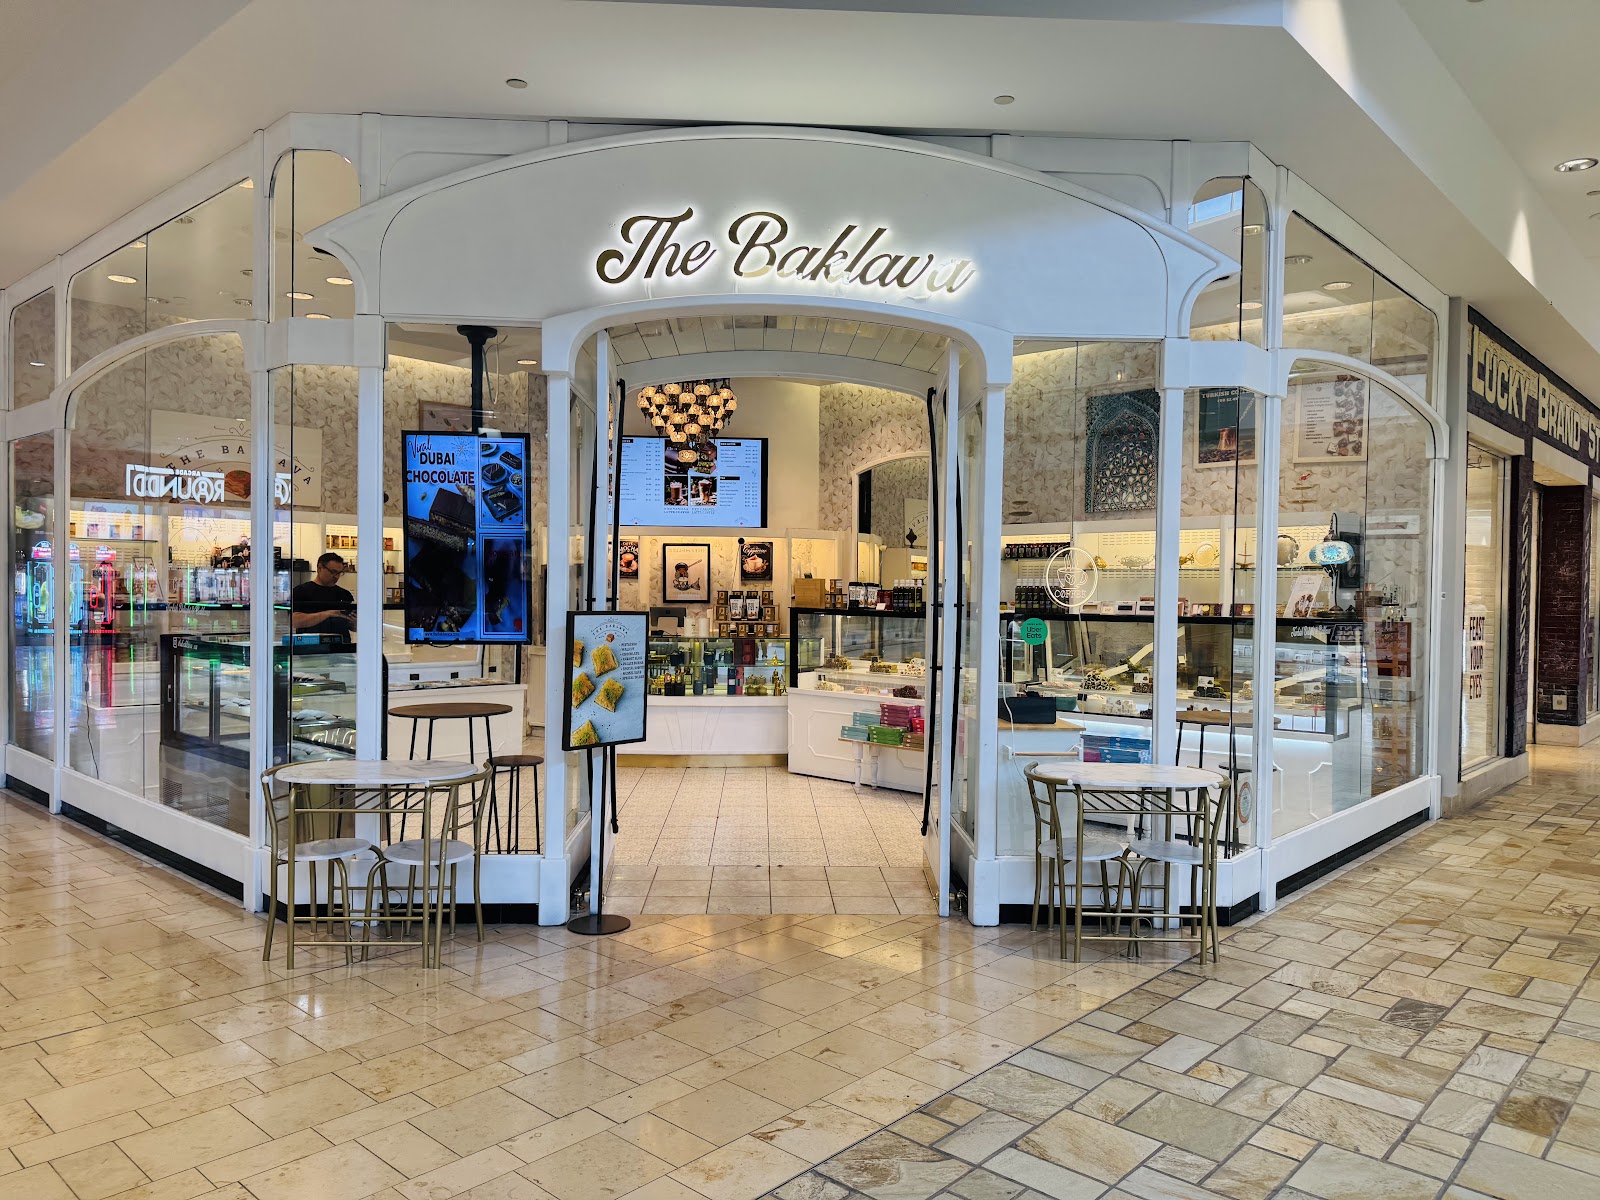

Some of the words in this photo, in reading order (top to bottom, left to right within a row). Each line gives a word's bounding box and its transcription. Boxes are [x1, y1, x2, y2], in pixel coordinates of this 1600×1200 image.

[596, 207, 717, 284] The
[728, 211, 976, 294] Baklava
[1471, 324, 1531, 422] LUCKY
[1537, 373, 1582, 452] BRAND
[407, 434, 432, 459] Viral
[419, 452, 456, 466] DUBAI
[165, 448, 206, 472] THE
[220, 445, 312, 486] BAAVA
[406, 469, 475, 485] CHOCOLATE
[1054, 589, 1087, 599] COFFEE
[1469, 616, 1485, 641] FEAST
[1469, 674, 1483, 699] EYES
